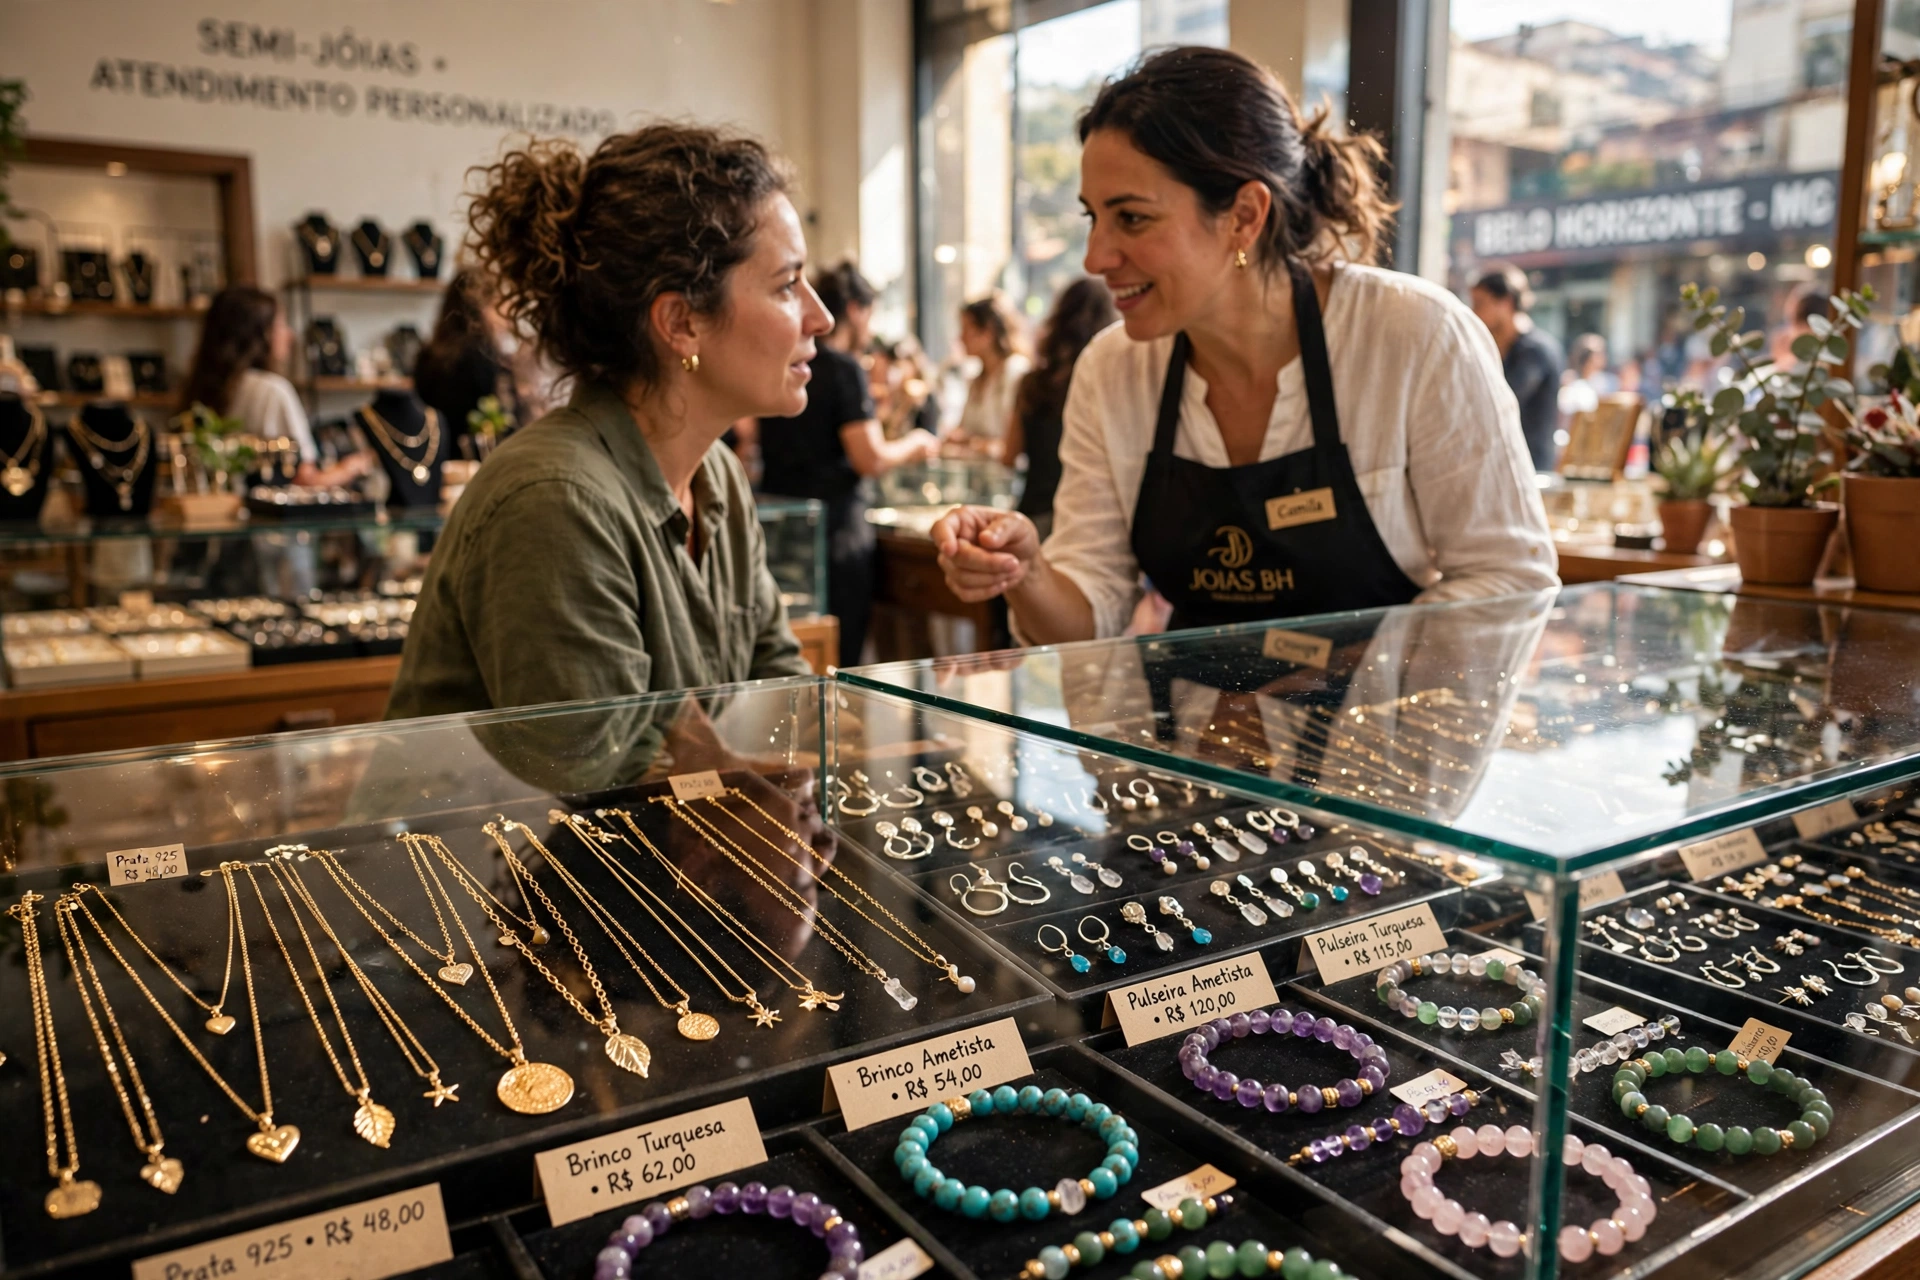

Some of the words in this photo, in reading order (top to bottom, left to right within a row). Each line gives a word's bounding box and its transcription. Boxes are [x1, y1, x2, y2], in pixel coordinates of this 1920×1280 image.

[199, 18, 420, 77] SEMI-JÓIAS
[90, 57, 355, 116] ATENDIMENTO
[366, 86, 615, 137] PERSONALIZADO
[1475, 207, 1553, 256] BELO
[1555, 187, 1745, 249] HORIZONTE
[1770, 178, 1835, 230] MG
[1189, 568, 1256, 591] JOIAS
[1260, 568, 1295, 591] BH
[155, 850, 178, 861] 925
[1317, 931, 1368, 955] Pulseira
[1368, 915, 1425, 939] Turquesa
[1353, 949, 1371, 966] R$
[1373, 939, 1412, 961] 115,00
[1127, 984, 1187, 1010] Pulseira
[1192, 964, 1253, 993] Ametista
[1165, 1004, 1185, 1024] R$
[1190, 991, 1236, 1017] 120,00
[856, 1060, 914, 1088] Brinco
[922, 1035, 995, 1070] Ametista
[905, 1077, 928, 1100] R$
[934, 1063, 982, 1092] 54,00
[566, 1147, 631, 1176] Brinco
[637, 1120, 725, 1153] Turquesa
[607, 1168, 633, 1194] R$
[642, 1153, 696, 1184] 62,00
[165, 1254, 236, 1280] Prata
[246, 1233, 293, 1267] 925
[324, 1217, 354, 1247] R$
[363, 1200, 425, 1233] 48,00
